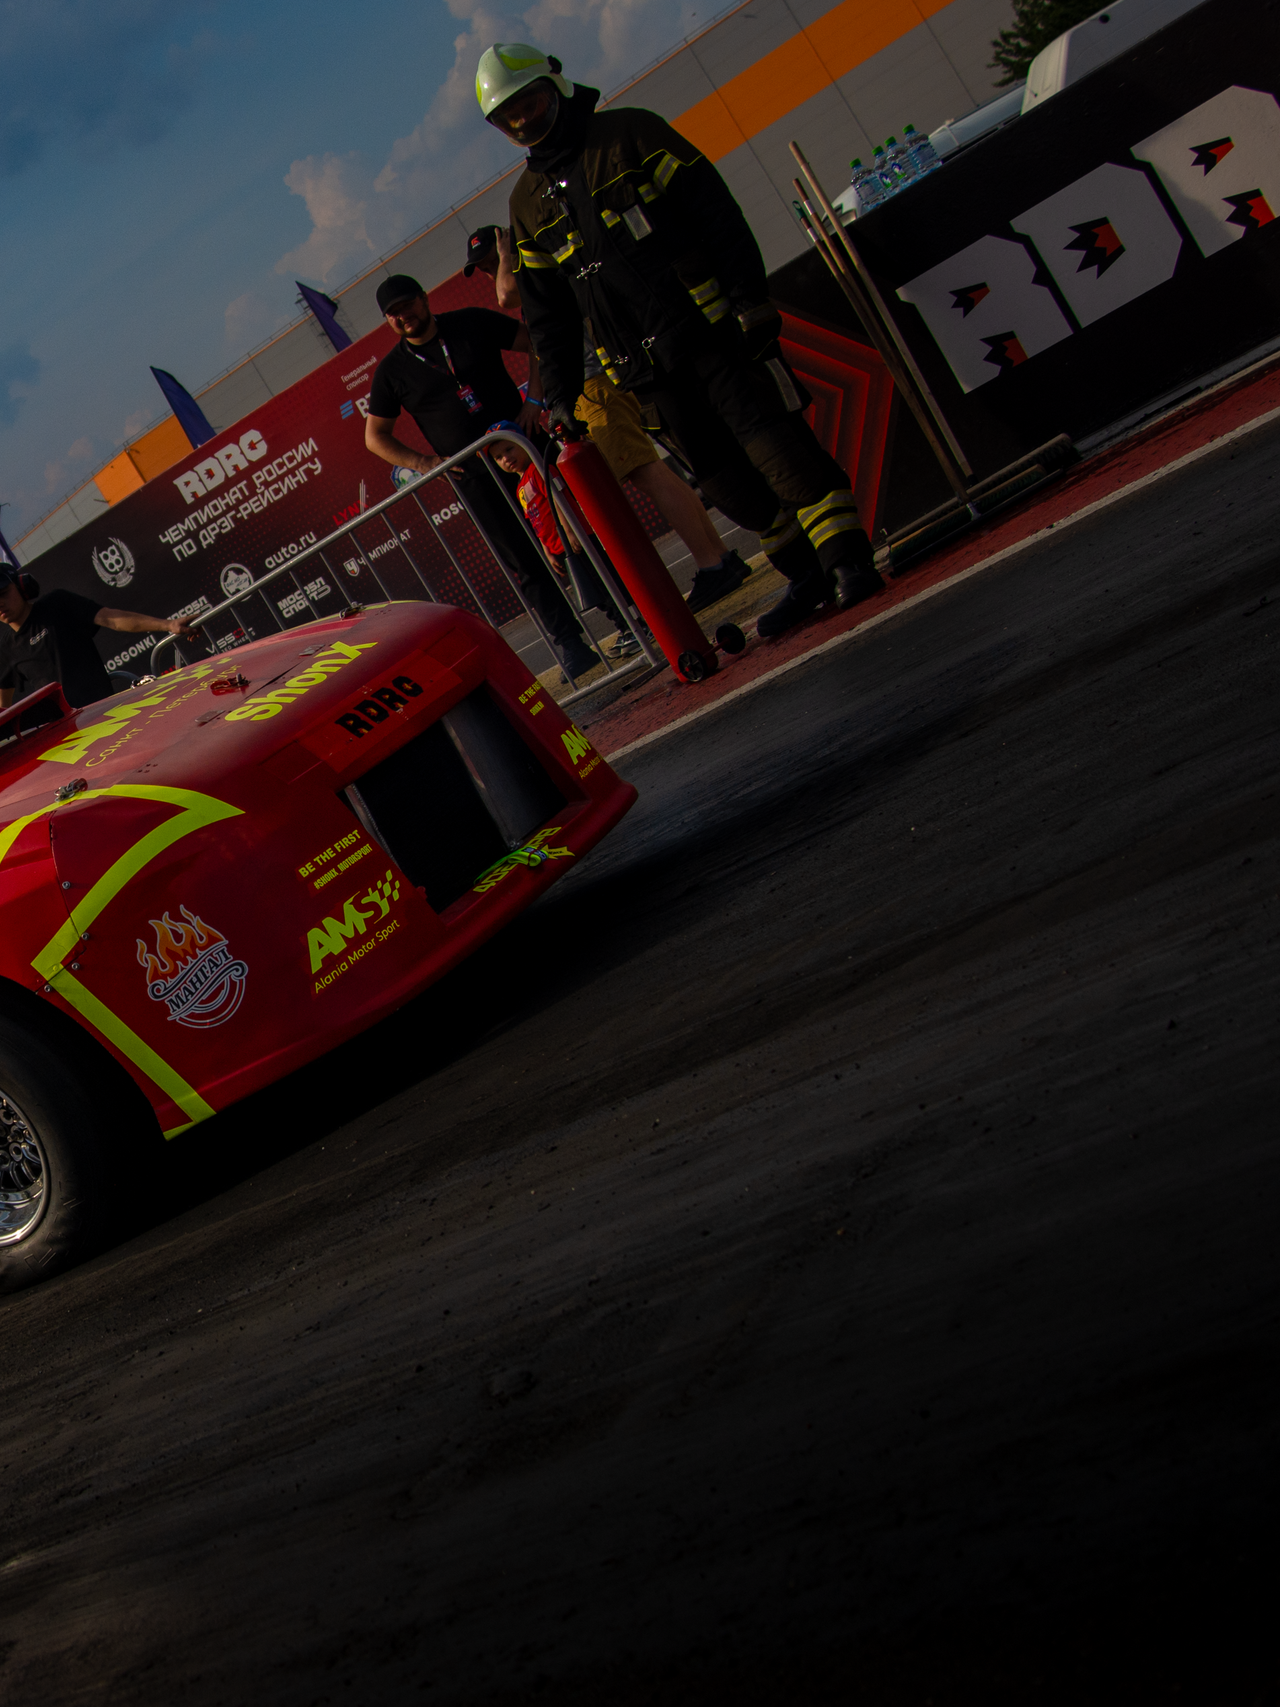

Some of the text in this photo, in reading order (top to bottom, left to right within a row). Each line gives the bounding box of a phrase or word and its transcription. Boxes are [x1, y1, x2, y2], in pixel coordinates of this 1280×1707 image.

[345, 372, 370, 391] спонсор
[158, 436, 319, 545] ЧЕМПИОНАТ РОССИИ
[172, 429, 268, 505] RDRC
[172, 457, 322, 562] ПО ДРЭГ-РЕЙСИНГУ
[264, 531, 317, 570] auto.ru
[334, 675, 424, 739] RDRC
[298, 829, 362, 878] BE THE FIRST
[166, 946, 233, 1013] МАНГАЛ
[314, 919, 401, 994] Alania Motor Sport
